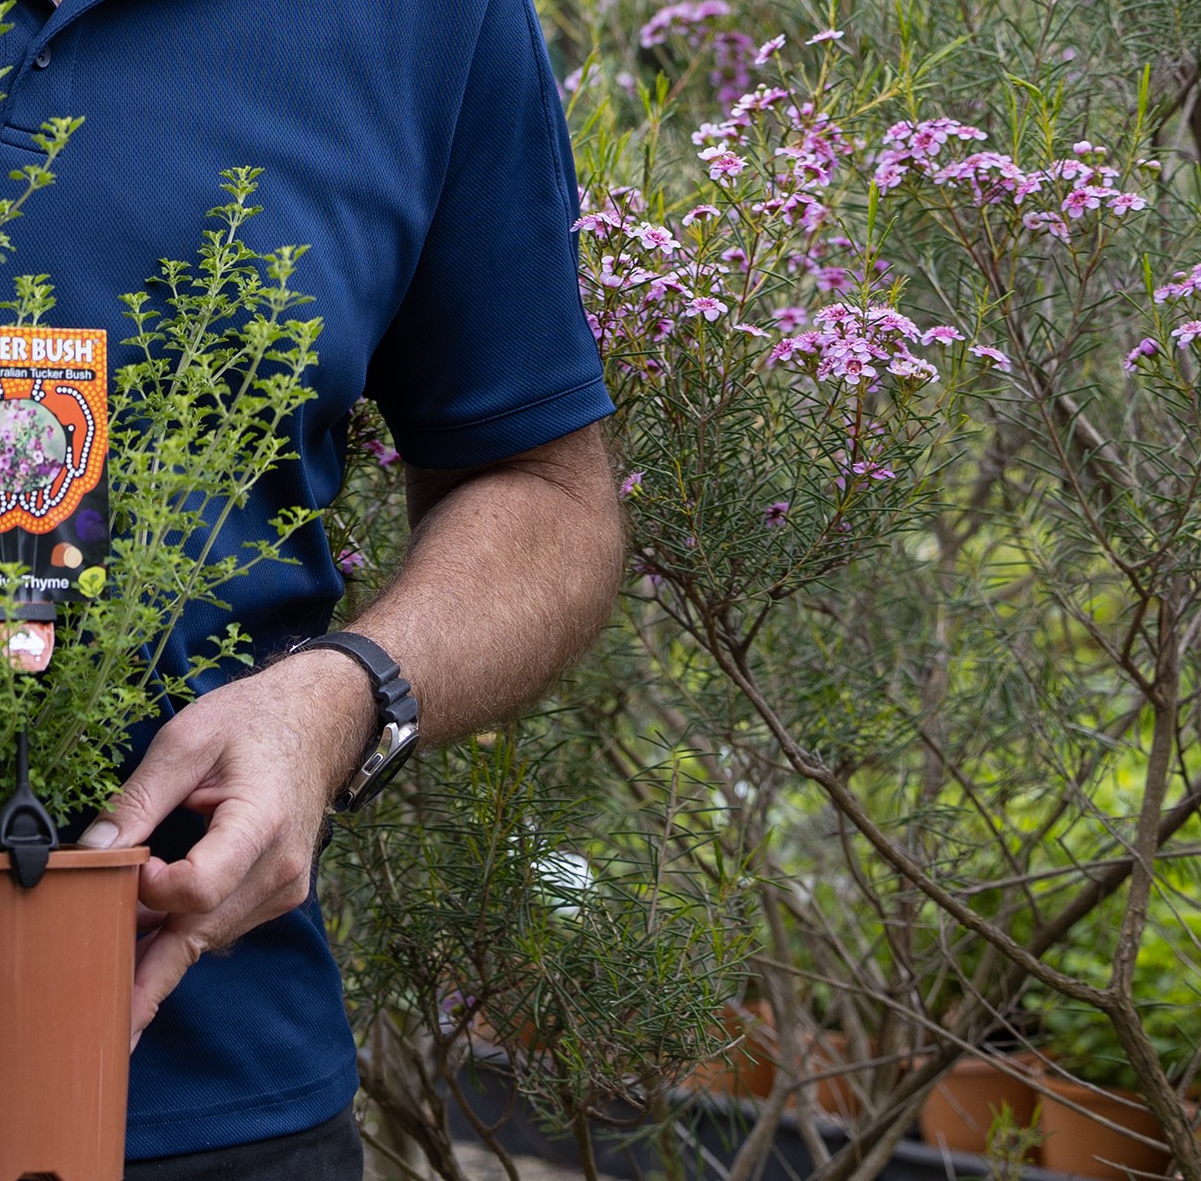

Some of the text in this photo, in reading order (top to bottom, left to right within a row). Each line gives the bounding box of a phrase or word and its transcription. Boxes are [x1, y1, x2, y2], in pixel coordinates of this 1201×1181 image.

[32, 337, 93, 363] BUSH
[31, 368, 62, 379] Tucker
[65, 370, 92, 380] Bush
[21, 574, 70, 592] Thyme
